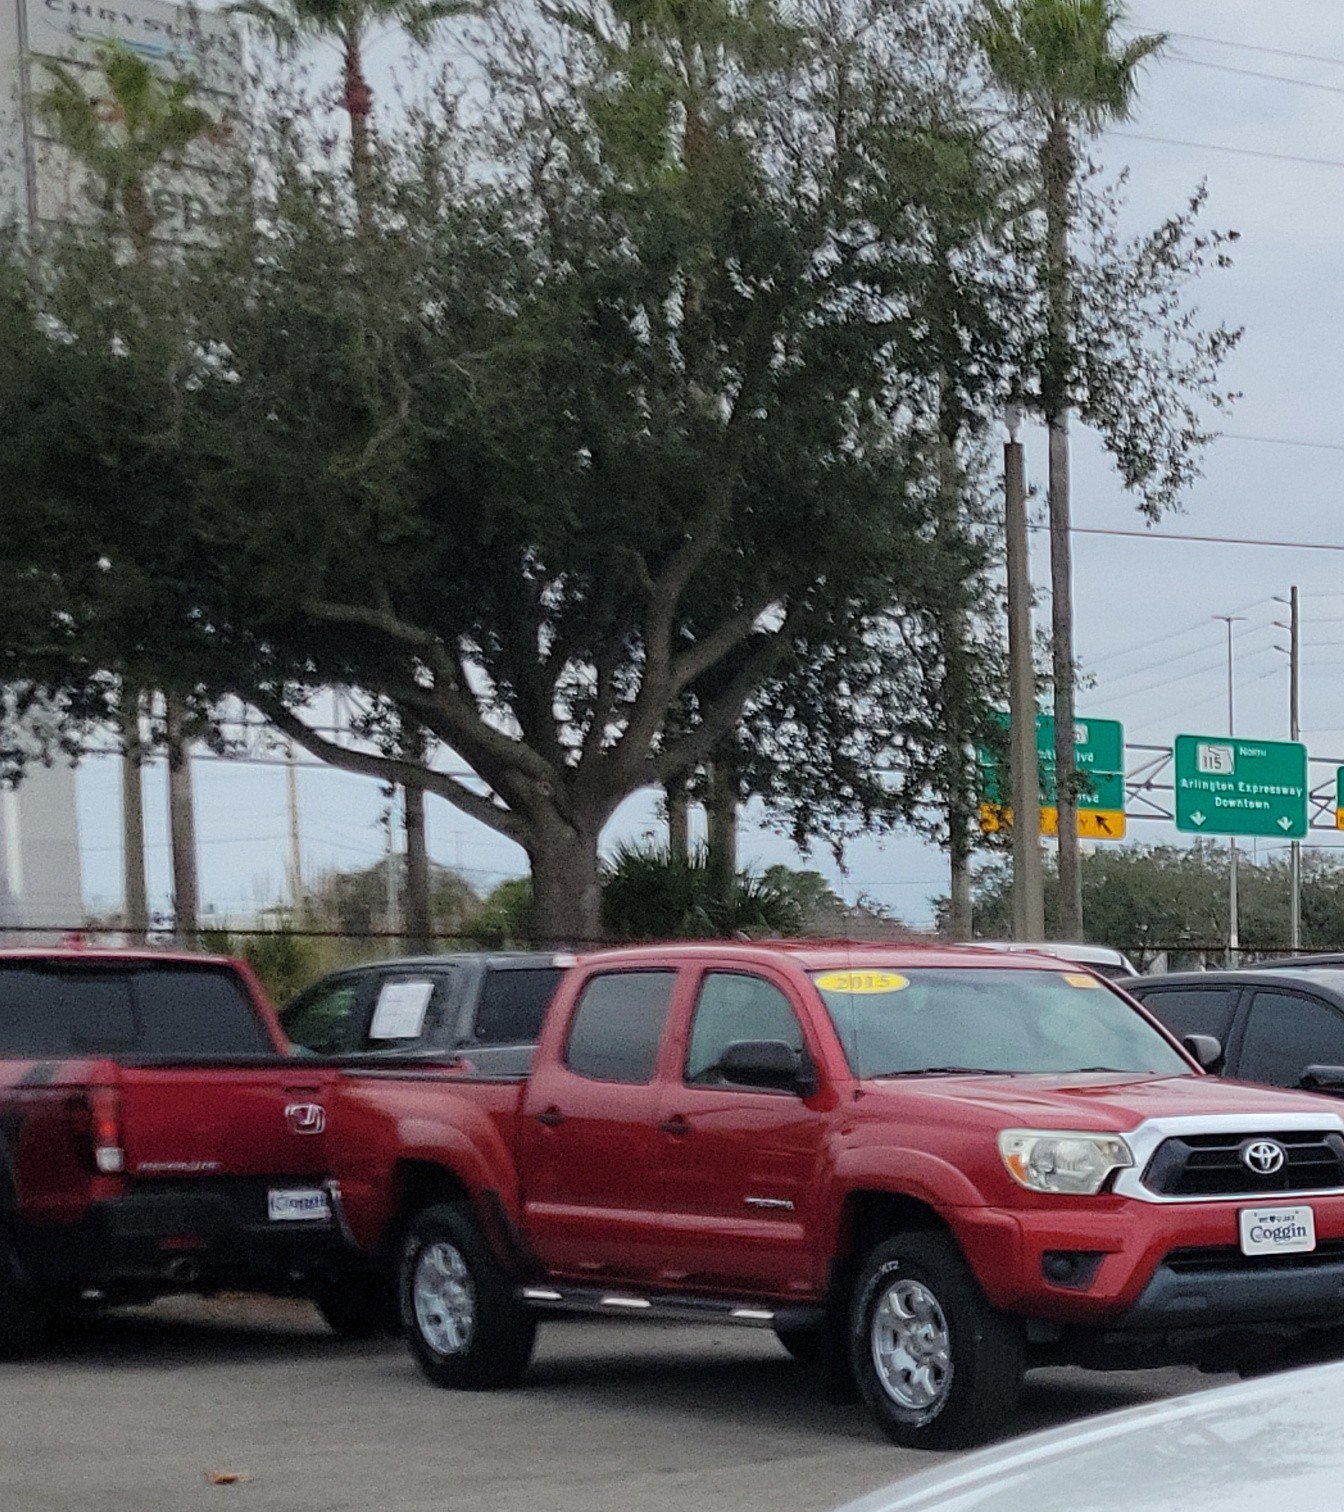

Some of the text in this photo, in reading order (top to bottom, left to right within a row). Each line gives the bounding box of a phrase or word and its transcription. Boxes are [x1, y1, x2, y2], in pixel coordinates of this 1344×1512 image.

[1203, 755, 1222, 770] 115
[1180, 778, 1303, 798] Arlington Expressway
[1214, 796, 1271, 810] Downtown
[836, 975, 890, 989] 2015
[1250, 1222, 1307, 1244] Coggin
